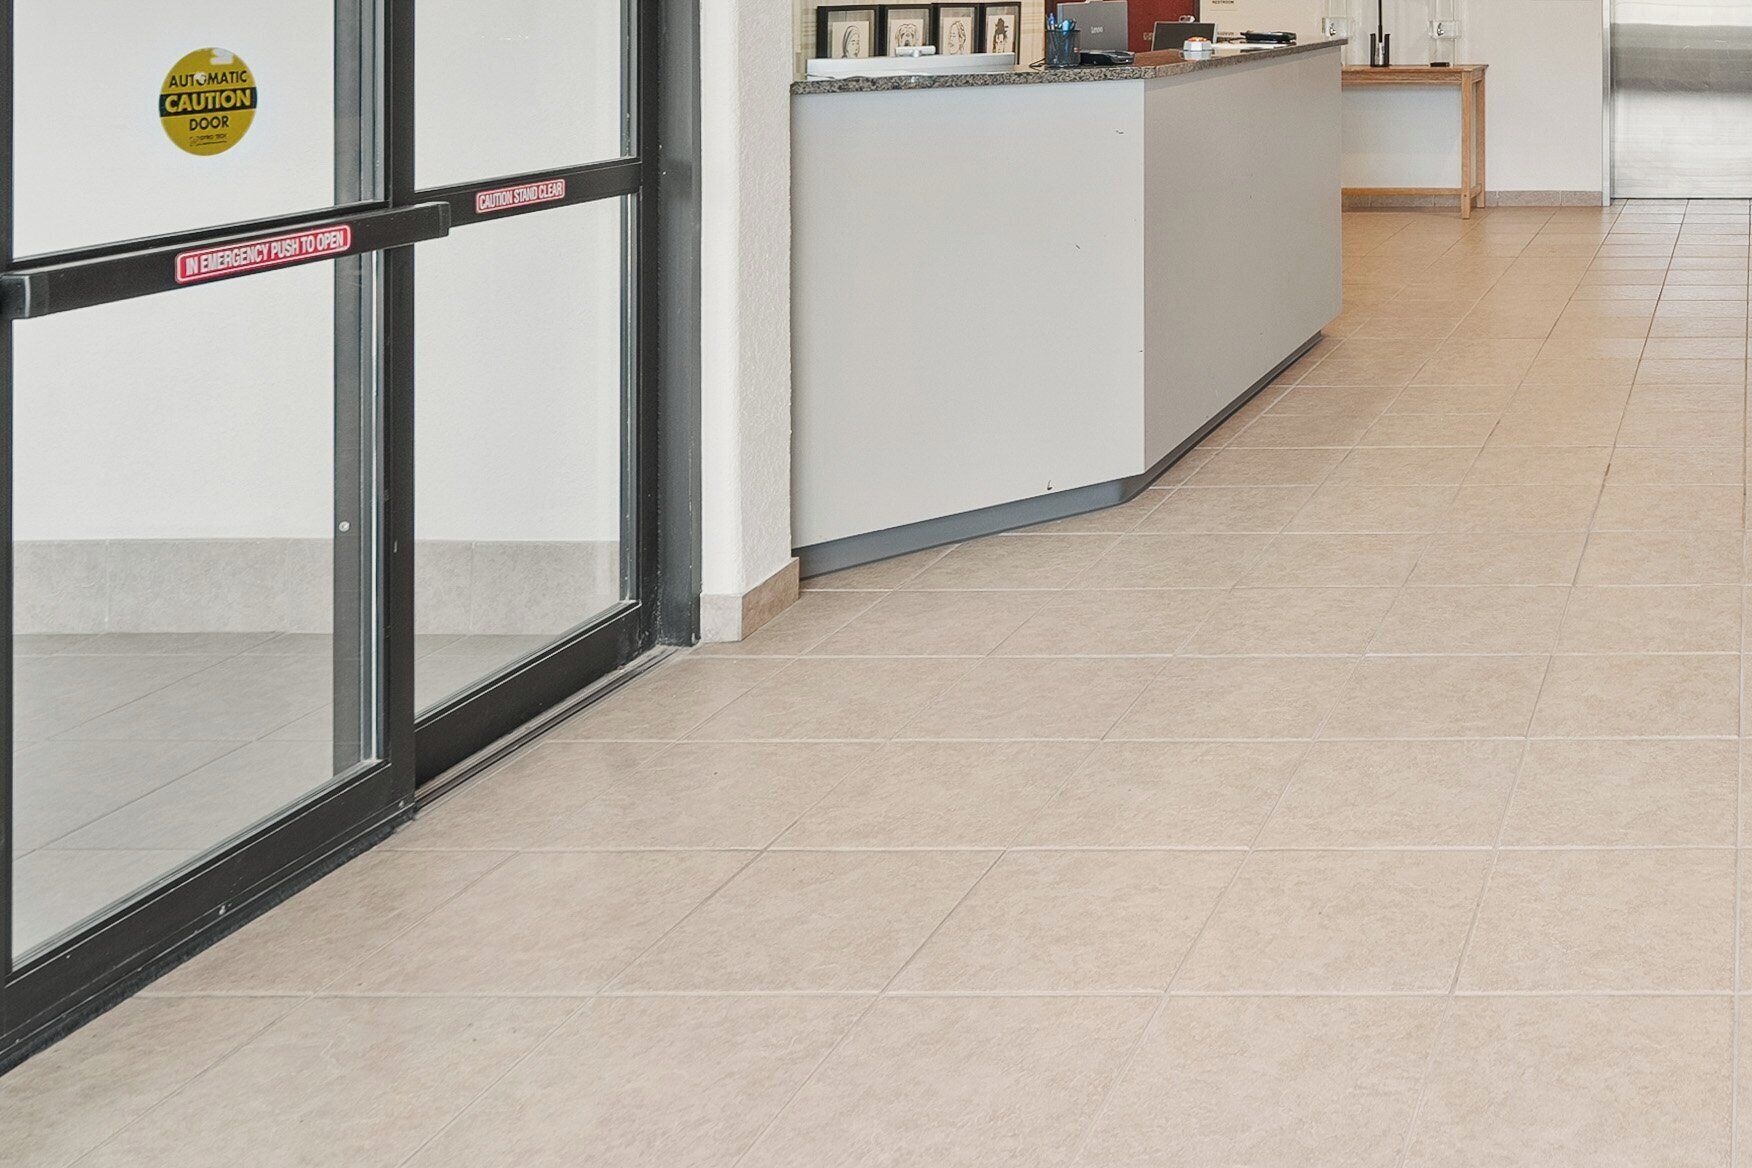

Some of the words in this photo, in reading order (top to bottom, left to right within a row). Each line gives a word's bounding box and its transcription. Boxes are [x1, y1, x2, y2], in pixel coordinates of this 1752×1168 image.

[169, 70, 247, 88] AUTOMATIC
[165, 89, 251, 113] CAUTION
[189, 115, 229, 131] DOOR
[480, 190, 513, 209] CAUTION
[514, 186, 537, 203] STAND
[539, 182, 562, 199] CLEAR
[185, 257, 198, 275] IN
[200, 242, 269, 272] EMERGENCY
[271, 238, 299, 260] PUSH
[301, 235, 314, 253] TO
[316, 231, 344, 250] OPEN
